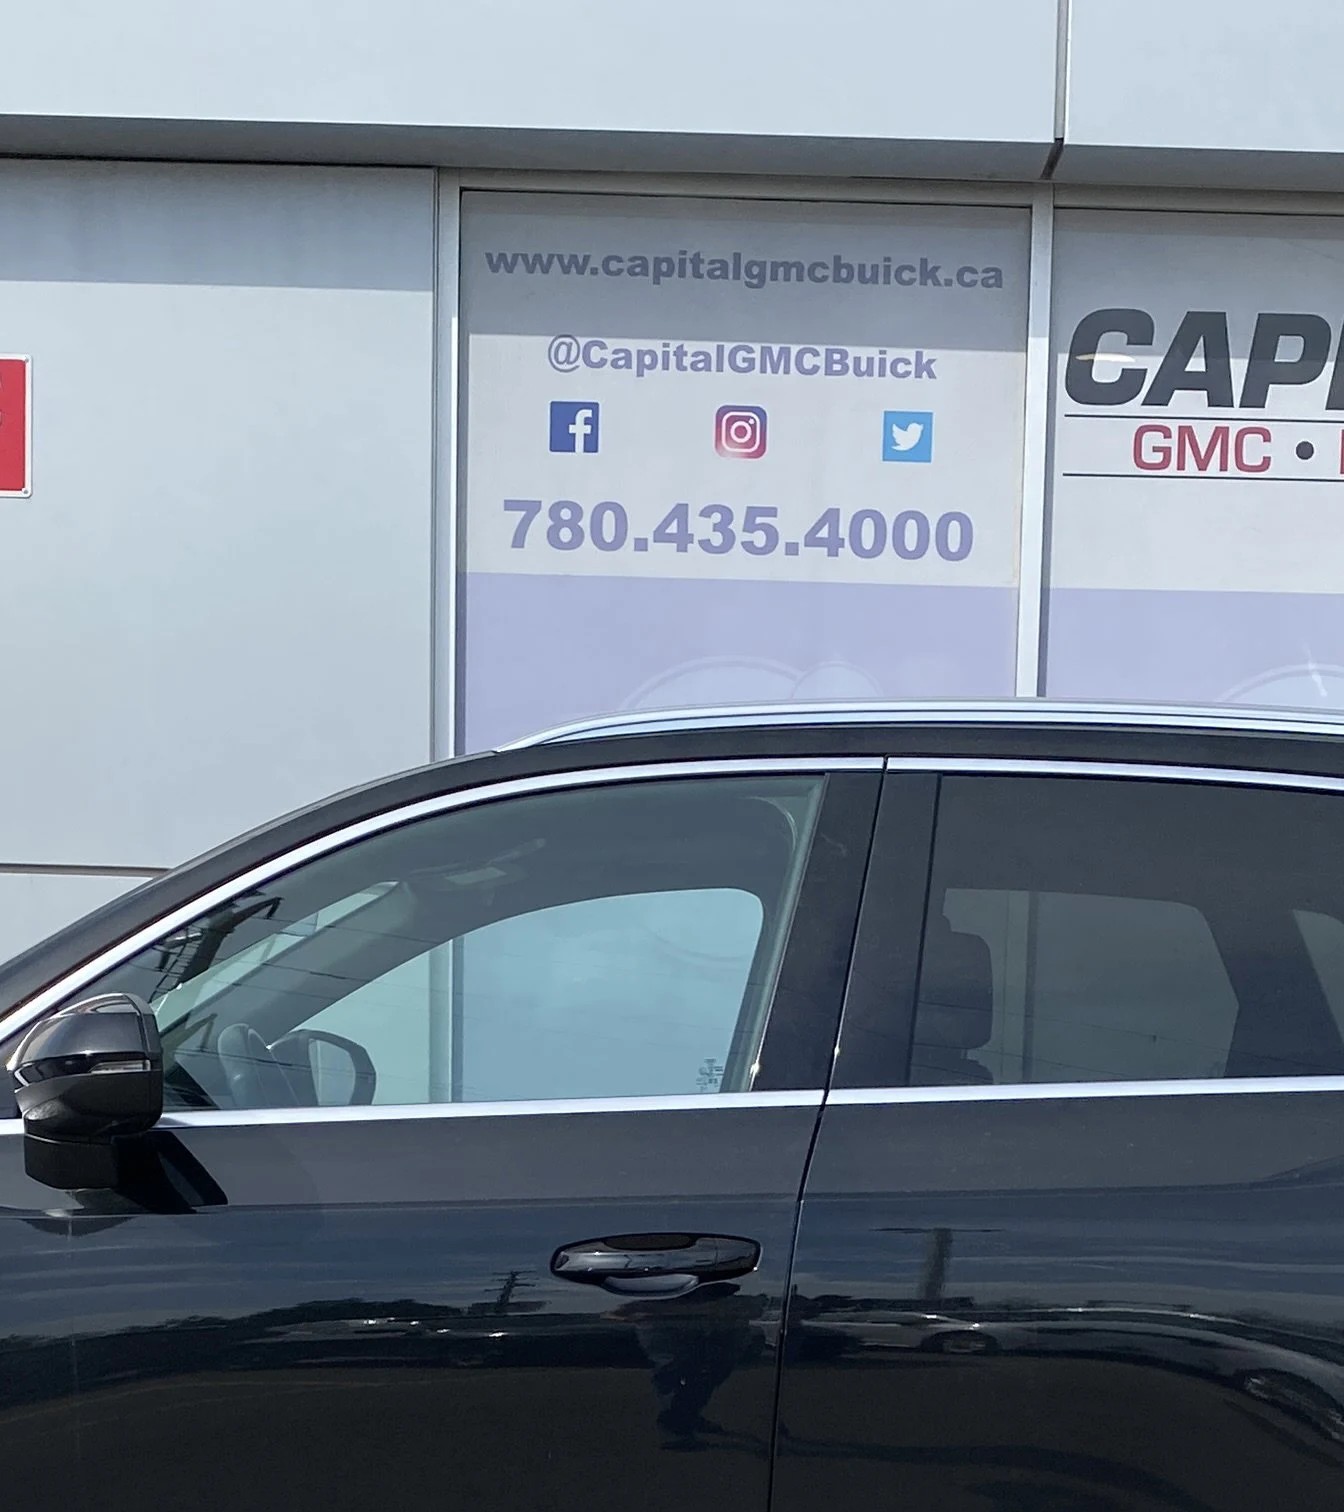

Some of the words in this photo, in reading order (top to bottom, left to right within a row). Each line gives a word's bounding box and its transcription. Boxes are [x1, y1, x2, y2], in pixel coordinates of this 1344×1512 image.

[484, 250, 1004, 289] www.capitalgmcbuick.ca
[547, 334, 938, 380] @CapitalGMCBuick
[1132, 424, 1272, 473] GMC
[502, 499, 975, 563] 780.435.4000
